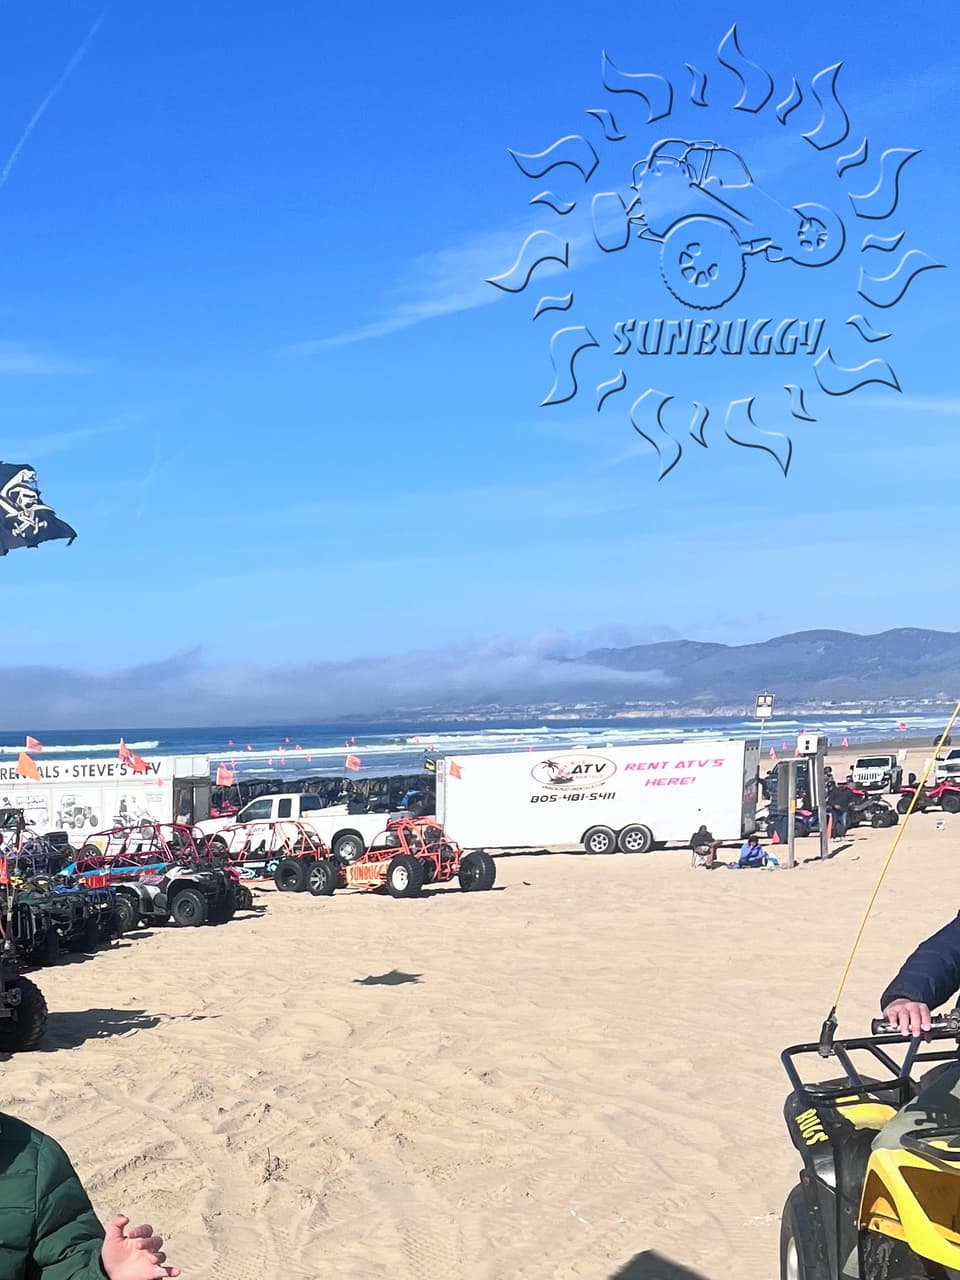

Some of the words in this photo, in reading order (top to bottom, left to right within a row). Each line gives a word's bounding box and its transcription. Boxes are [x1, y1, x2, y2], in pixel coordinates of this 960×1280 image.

[571, 763, 607, 775] ATV
[624, 761, 670, 771] RENT
[674, 758, 726, 769] ATV'S
[0, 765, 60, 780] REALS
[72, 763, 128, 778] STEVE'S
[645, 776, 696, 787] HERE!
[530, 792, 616, 803] 805-481-5411
